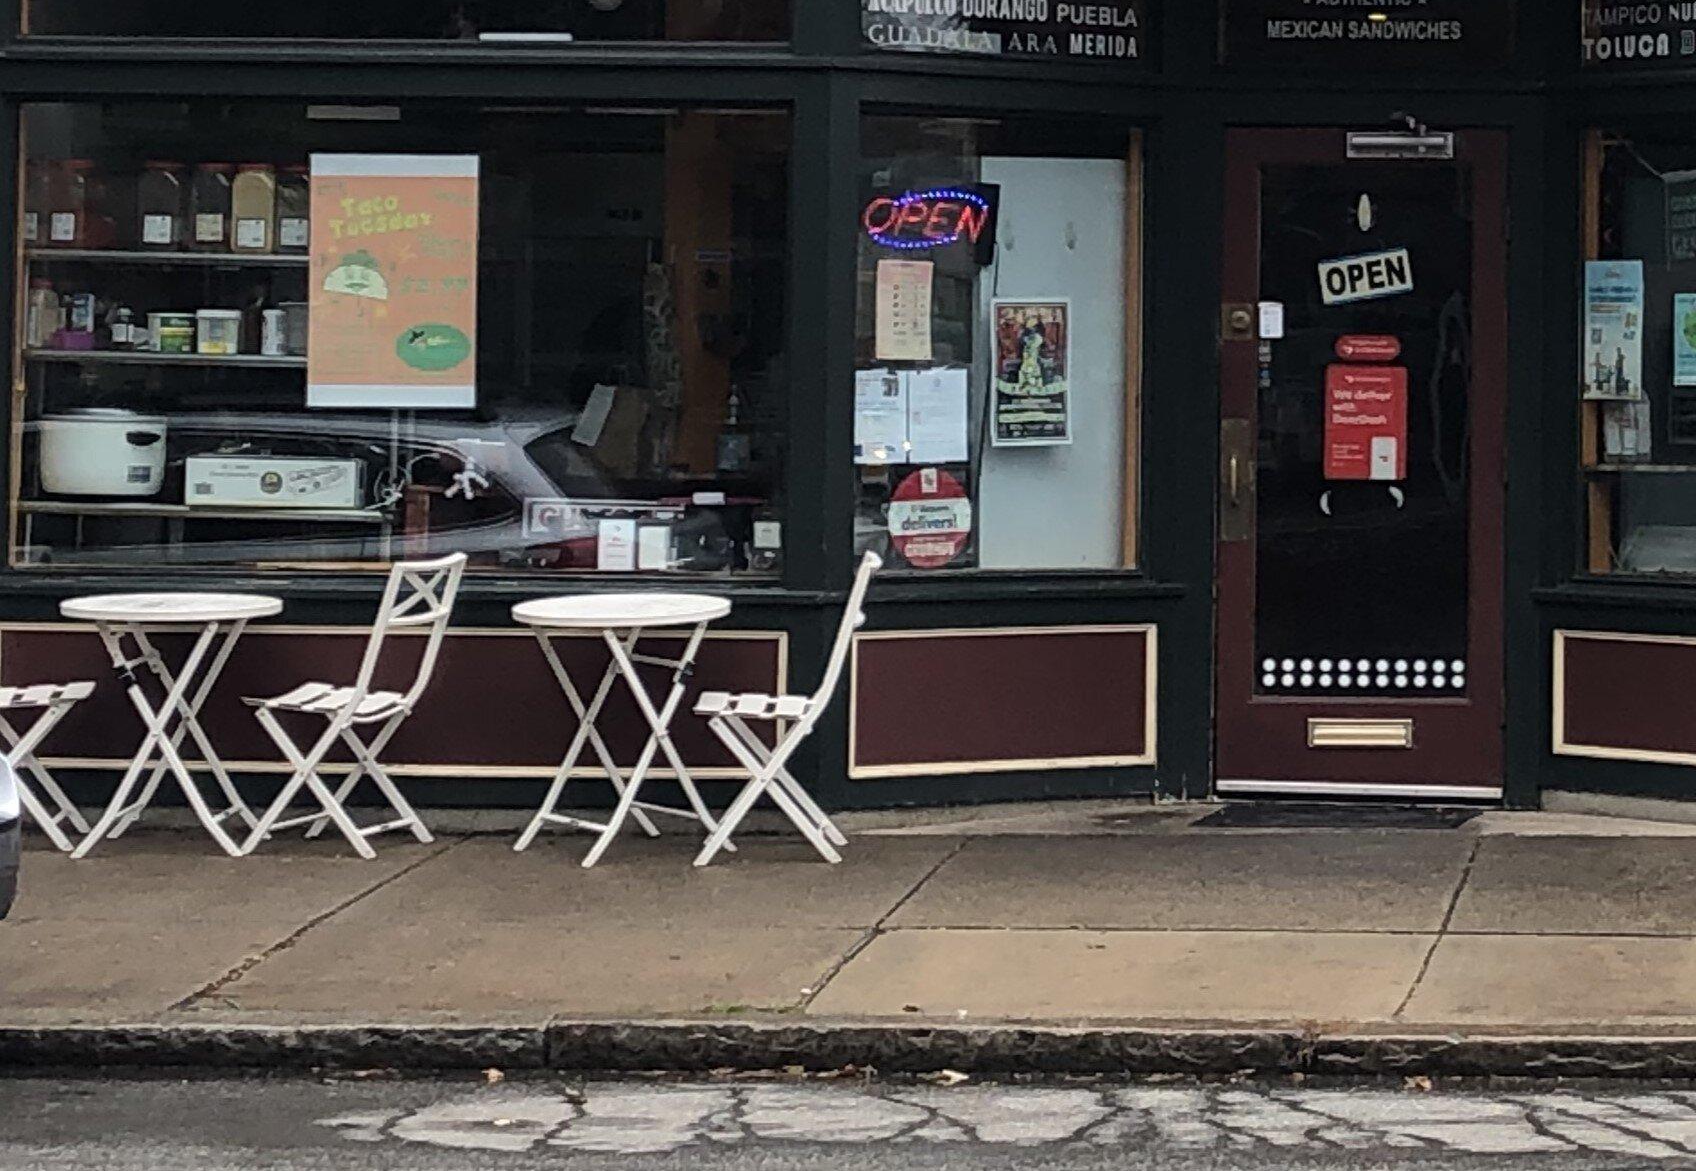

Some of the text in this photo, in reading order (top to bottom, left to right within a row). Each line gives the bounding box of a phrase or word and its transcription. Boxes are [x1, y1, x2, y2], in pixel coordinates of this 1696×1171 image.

[1056, 3, 1138, 27] PUEBLA
[1267, 20, 1462, 40] MEXICAN SANDWICHES
[867, 24, 1138, 58] GUADALAARA MERIDA
[1582, 33, 1670, 60] TOLUCA
[864, 198, 988, 243] OPEN
[1325, 255, 1407, 296] OPEN
